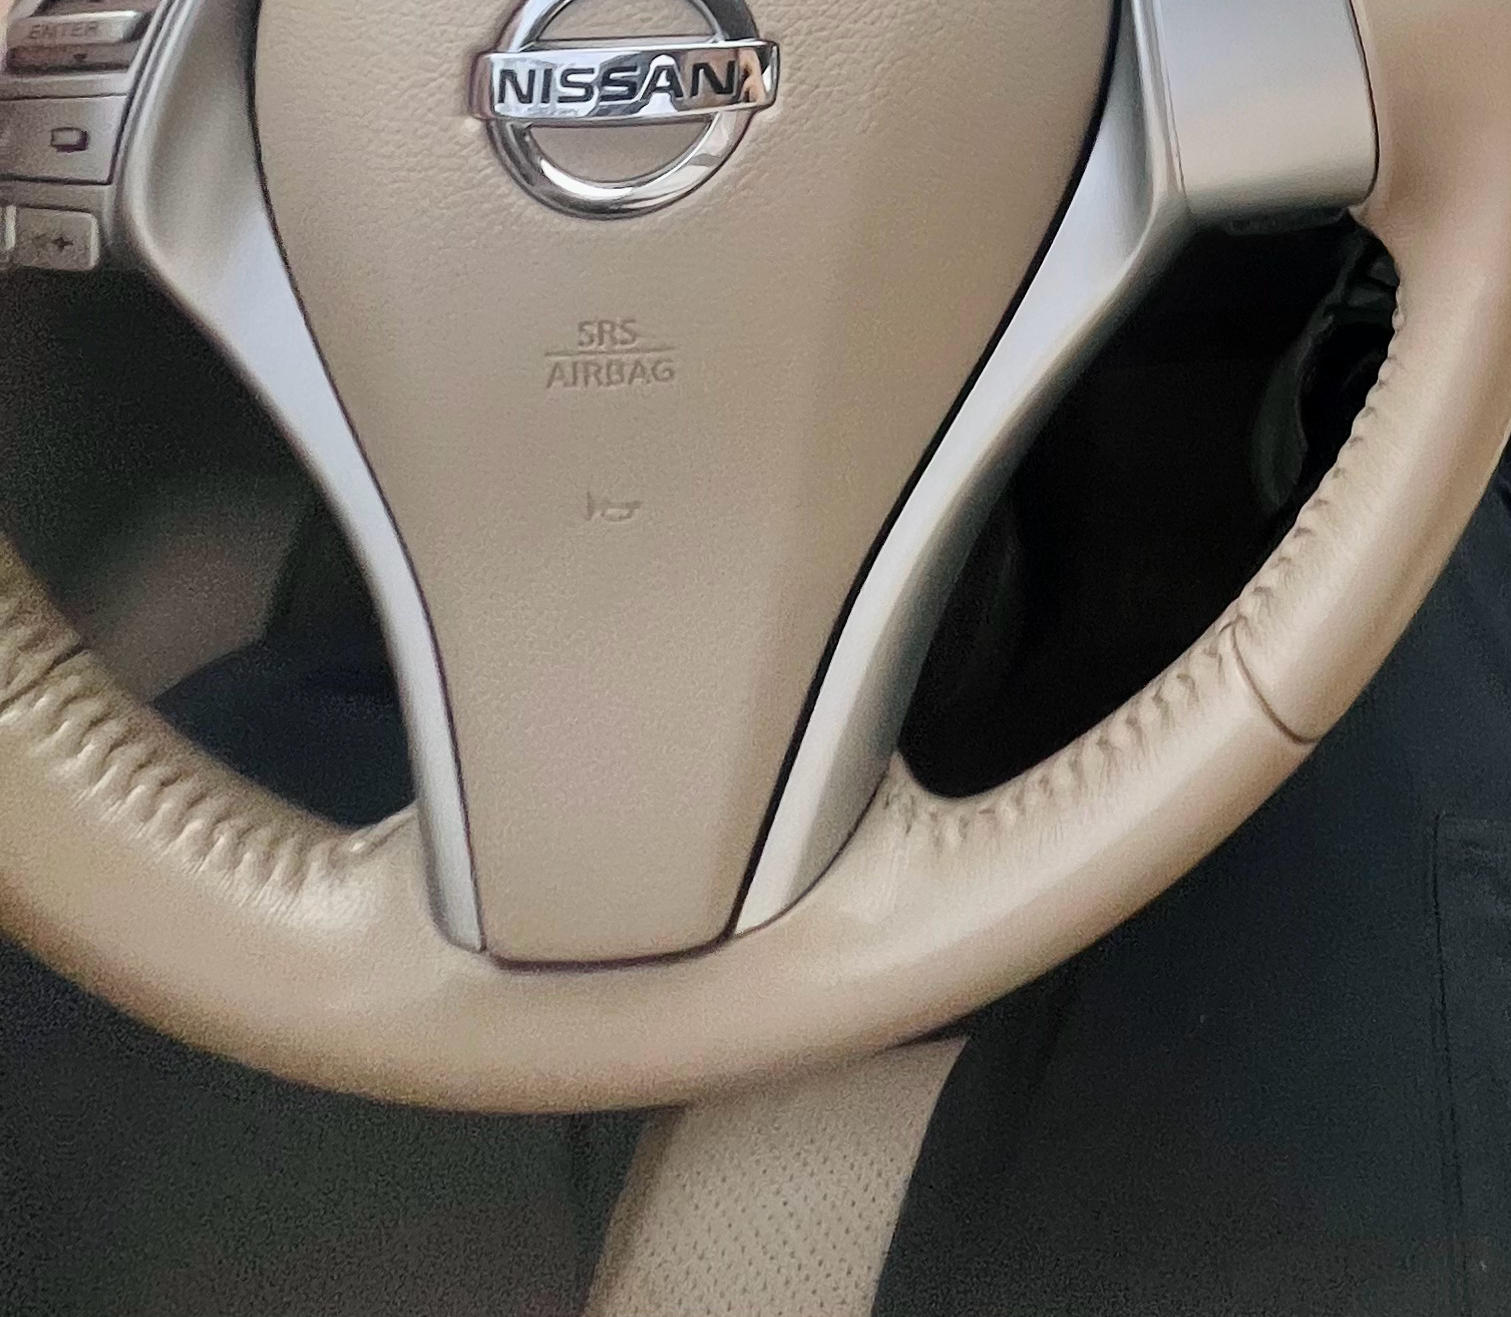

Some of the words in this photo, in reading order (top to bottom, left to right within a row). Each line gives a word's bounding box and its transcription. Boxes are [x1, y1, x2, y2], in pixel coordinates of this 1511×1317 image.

[496, 60, 738, 105] NISSAN
[577, 319, 640, 348] SRS
[545, 358, 676, 389] AIRBAG
